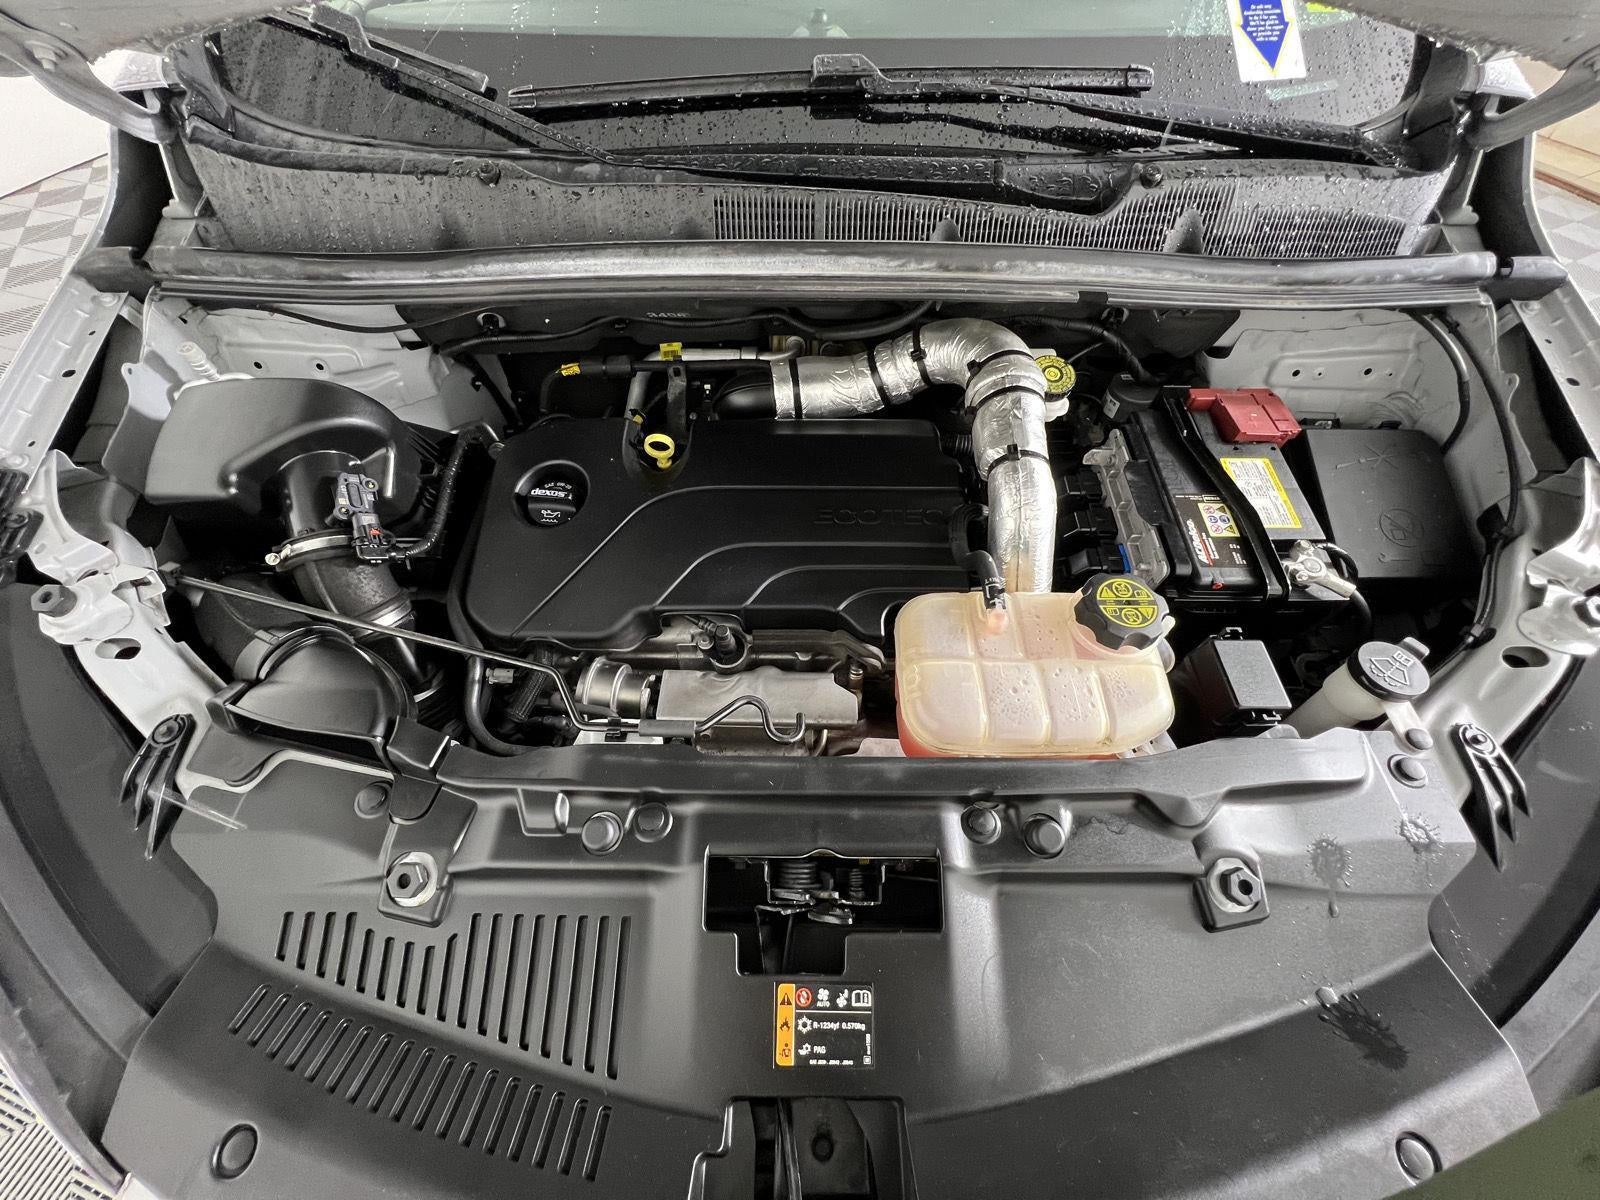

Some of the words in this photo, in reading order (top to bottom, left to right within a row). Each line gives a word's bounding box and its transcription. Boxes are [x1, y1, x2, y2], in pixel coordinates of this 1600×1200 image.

[813, 508, 945, 525] ECOTEC
[813, 1022, 840, 1030] R-1234yf
[842, 1022, 866, 1031] 0.570kg
[814, 1046, 826, 1054] PAG
